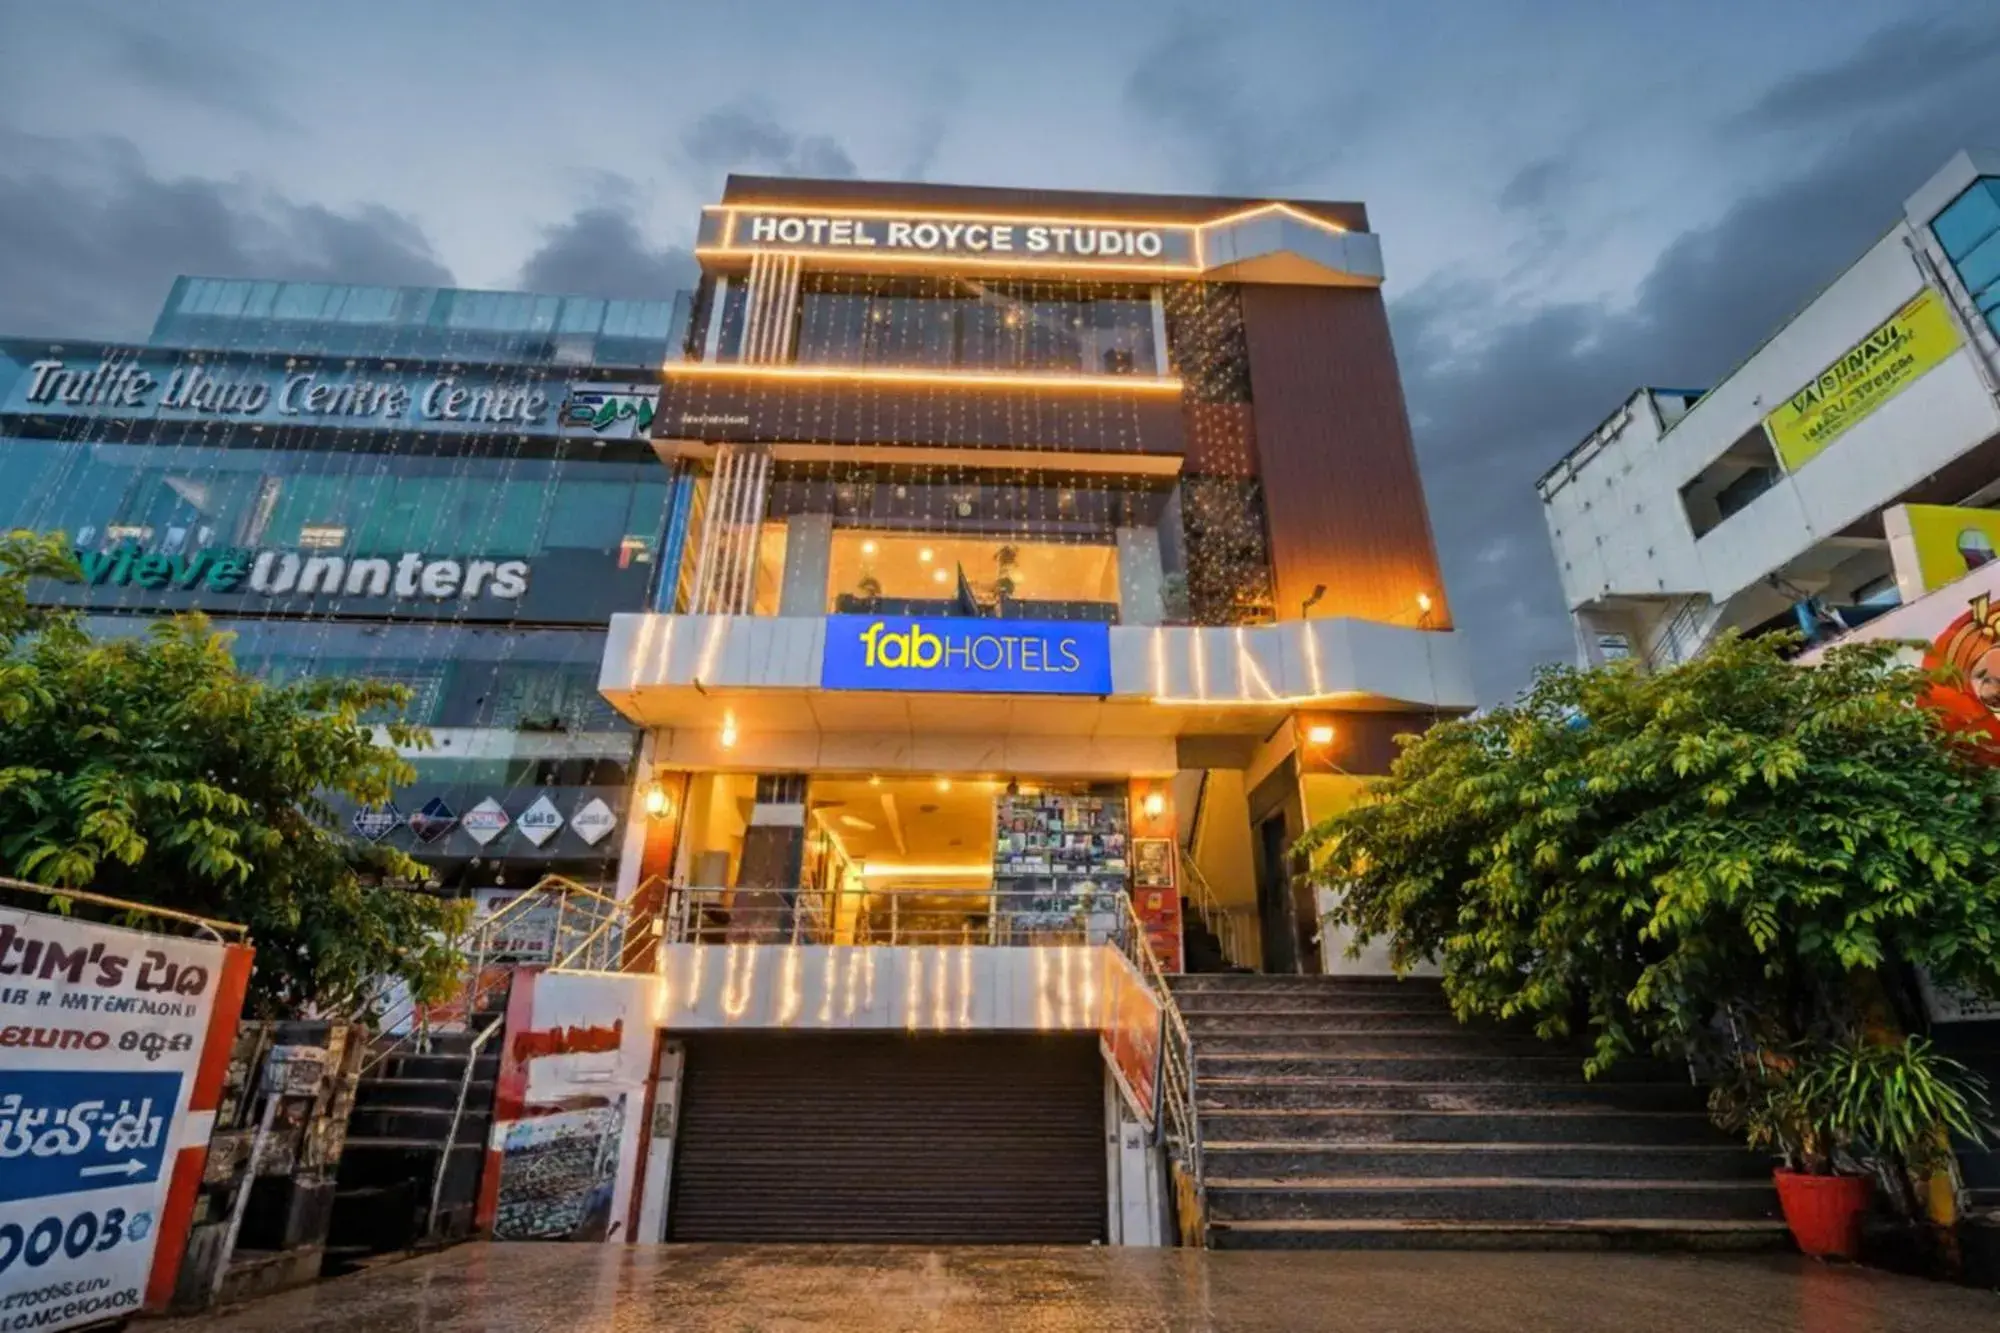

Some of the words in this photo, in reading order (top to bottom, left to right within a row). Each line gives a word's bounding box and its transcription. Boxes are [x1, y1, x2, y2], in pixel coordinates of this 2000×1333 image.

[752, 216, 875, 246] HOTEL
[888, 221, 1013, 251] ROYCE
[1026, 226, 1163, 257] STUDIO
